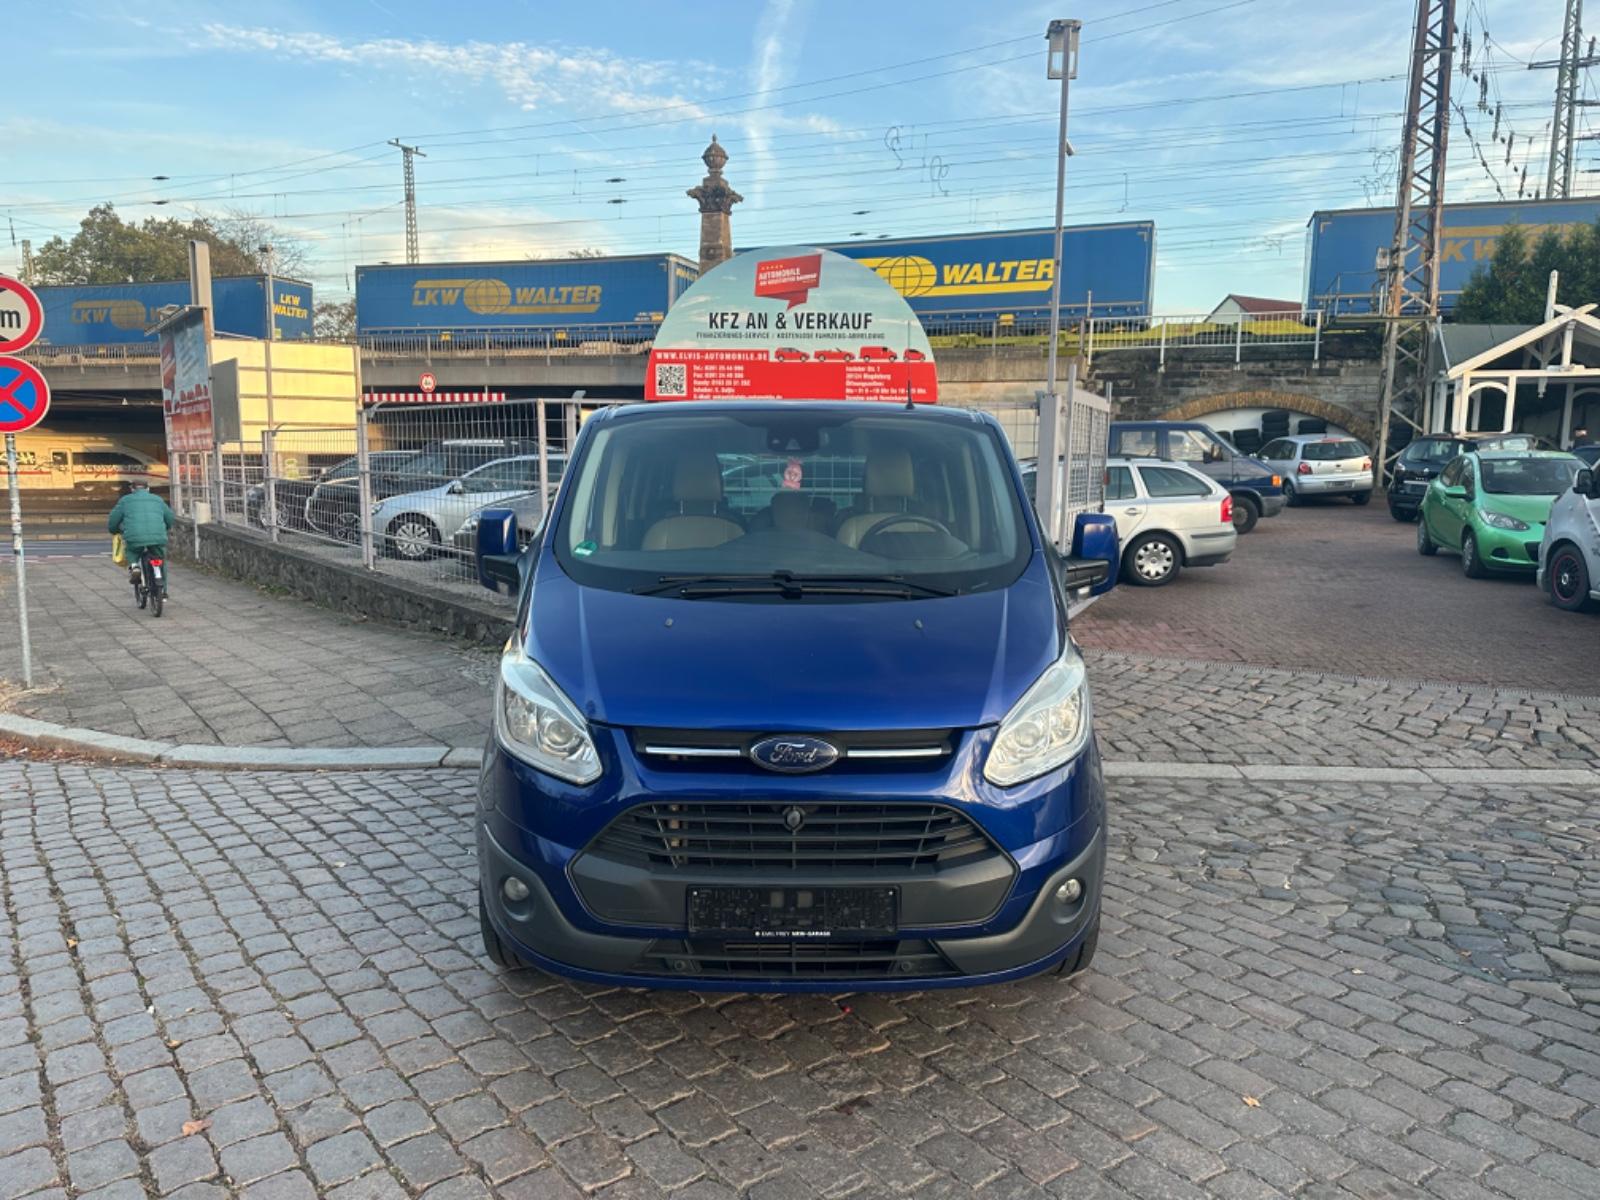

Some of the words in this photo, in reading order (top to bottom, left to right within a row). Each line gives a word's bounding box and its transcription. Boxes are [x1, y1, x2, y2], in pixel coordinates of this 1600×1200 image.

[943, 259, 1054, 286] WALTER
[280, 293, 301, 306] LKW
[412, 289, 462, 306] LKW
[516, 284, 602, 304] WALTER
[71, 308, 108, 324] LKW
[272, 303, 308, 319] WALTER
[708, 312, 740, 330] KFZ
[745, 312, 768, 330] AN
[775, 312, 787, 330] &
[794, 312, 873, 330] VERKAUF
[655, 351, 768, 361] WWW.ELVIS-AUTOMOBILE.DE
[770, 742, 818, 763] Ford
